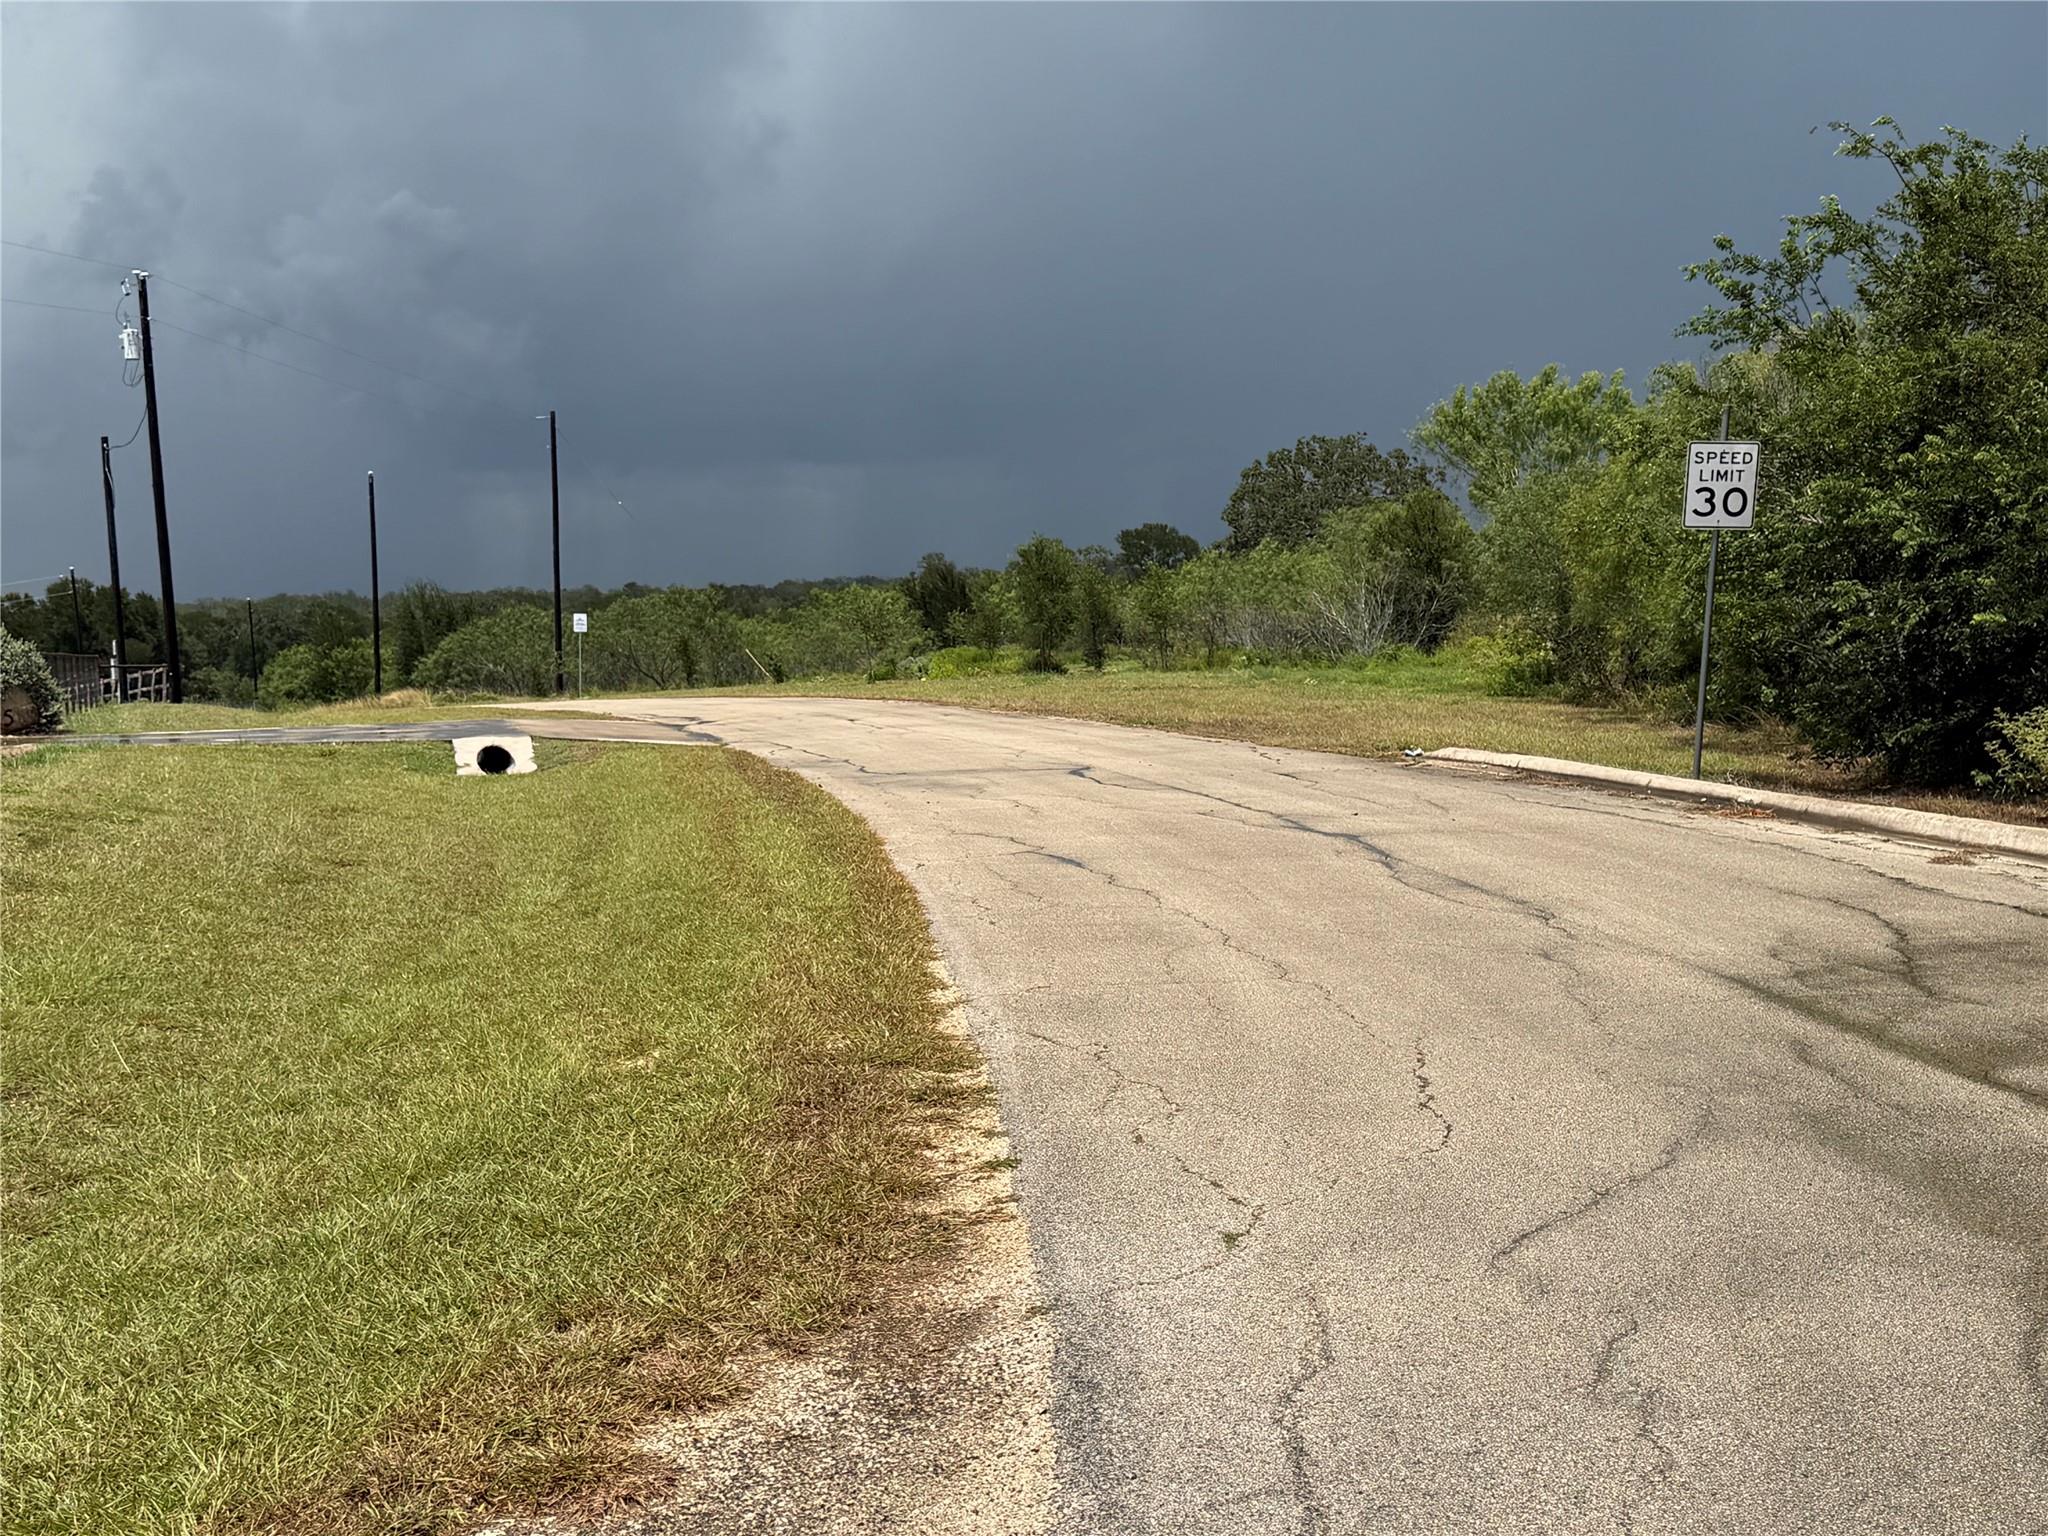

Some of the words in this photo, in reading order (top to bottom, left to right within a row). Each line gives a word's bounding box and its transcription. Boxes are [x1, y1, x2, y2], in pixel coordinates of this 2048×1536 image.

[1694, 451, 1753, 465] SPEED
[1699, 469, 1745, 482] LIMIT
[1692, 487, 1748, 517] 30
